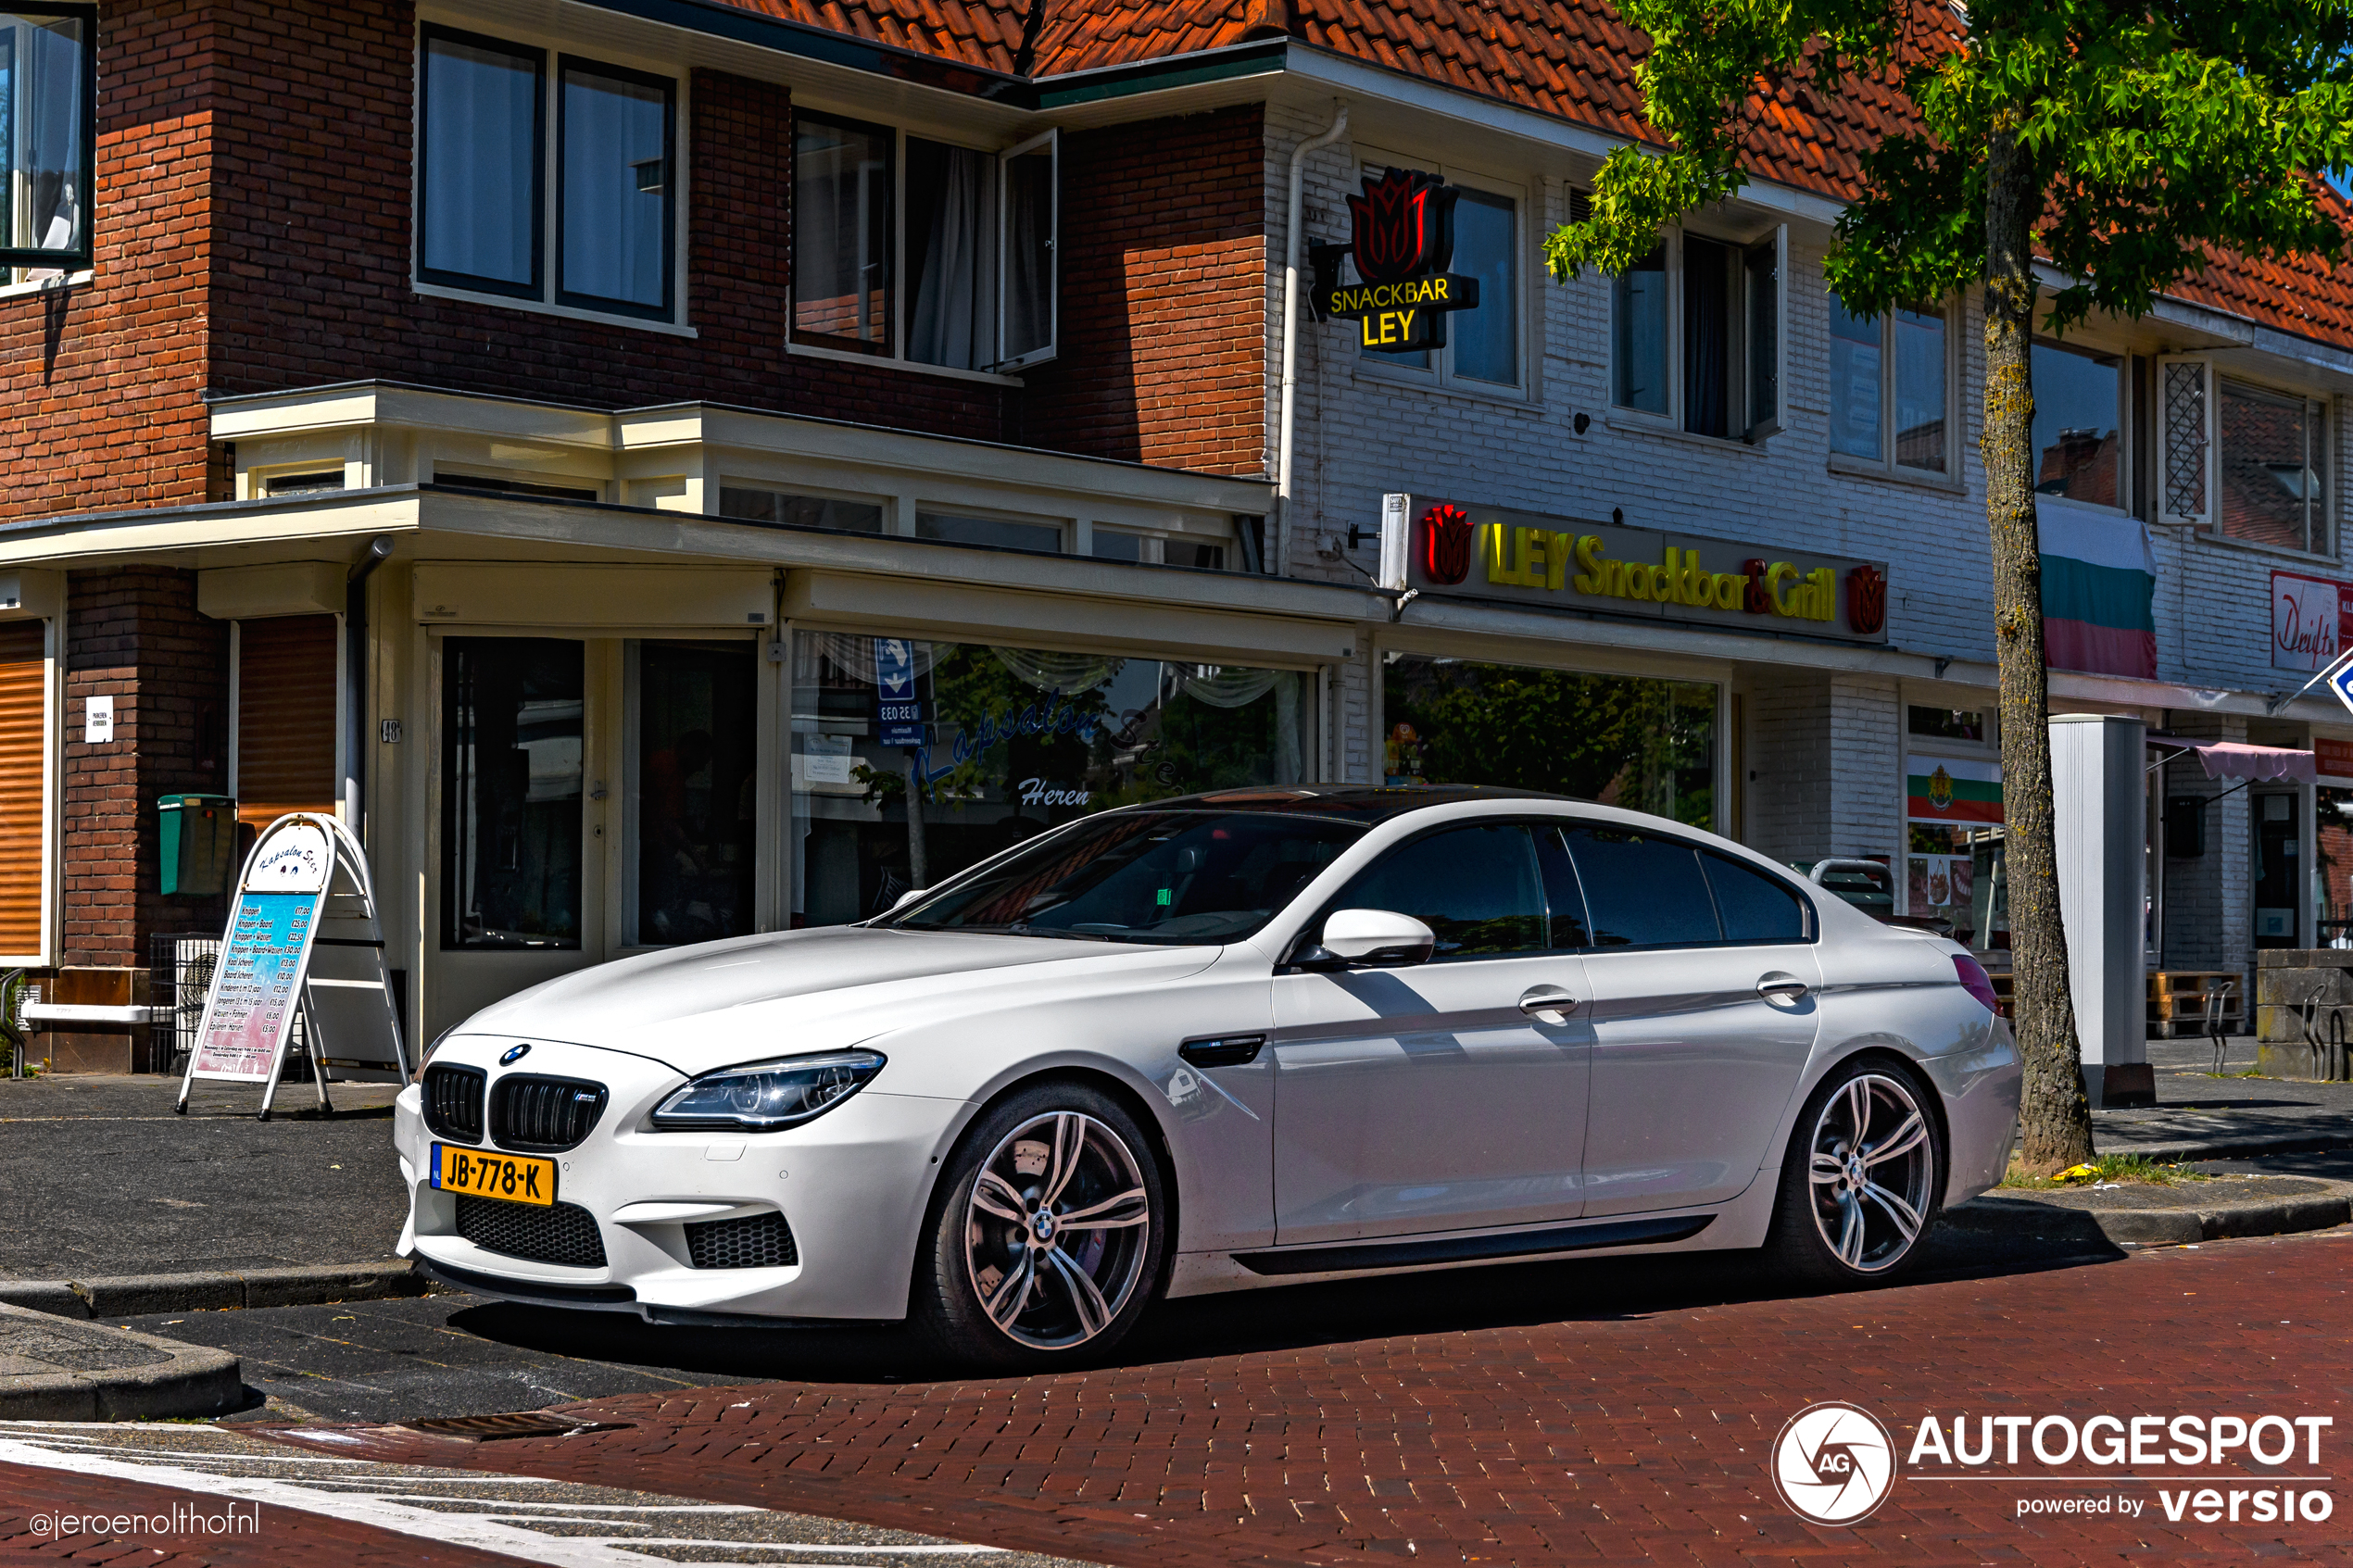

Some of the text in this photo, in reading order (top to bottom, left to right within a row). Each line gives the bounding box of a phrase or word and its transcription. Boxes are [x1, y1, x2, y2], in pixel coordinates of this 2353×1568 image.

[1331, 278, 1449, 313] SNACKBAR
[1363, 309, 1416, 346] LEY
[1489, 523, 1836, 621] LEY Snackbar & Grill
[2277, 592, 2329, 670] Drift
[911, 686, 1101, 804] Kapsalon
[1018, 778, 1089, 806] Heren
[259, 845, 302, 873] Kapsalon
[237, 919, 257, 930] Knippen
[241, 906, 260, 916] Knippen
[231, 945, 249, 955] Knippen
[234, 932, 253, 942] Knippen
[433, 1169, 441, 1181] NL
[447, 1153, 541, 1199] JB-778-K
